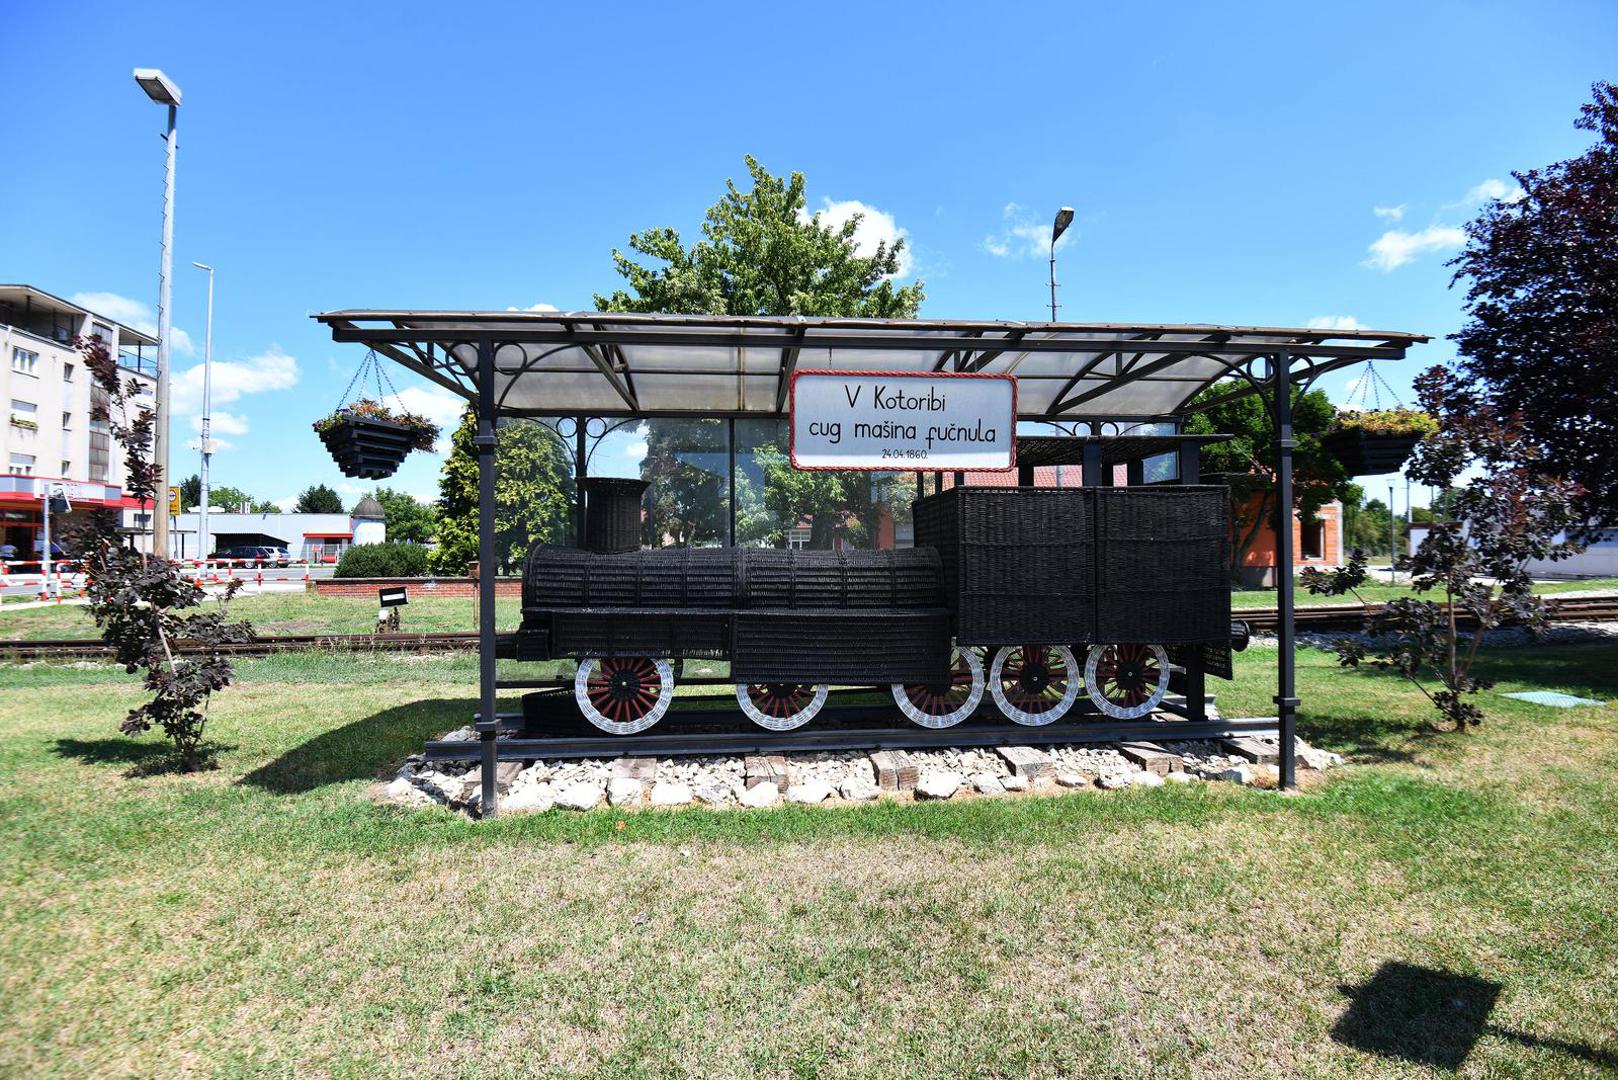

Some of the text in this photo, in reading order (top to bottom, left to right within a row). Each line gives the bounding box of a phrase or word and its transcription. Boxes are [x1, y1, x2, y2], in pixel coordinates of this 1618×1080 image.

[845, 385, 946, 411] V Kotoribi
[809, 418, 996, 449] cug mašina fučnula
